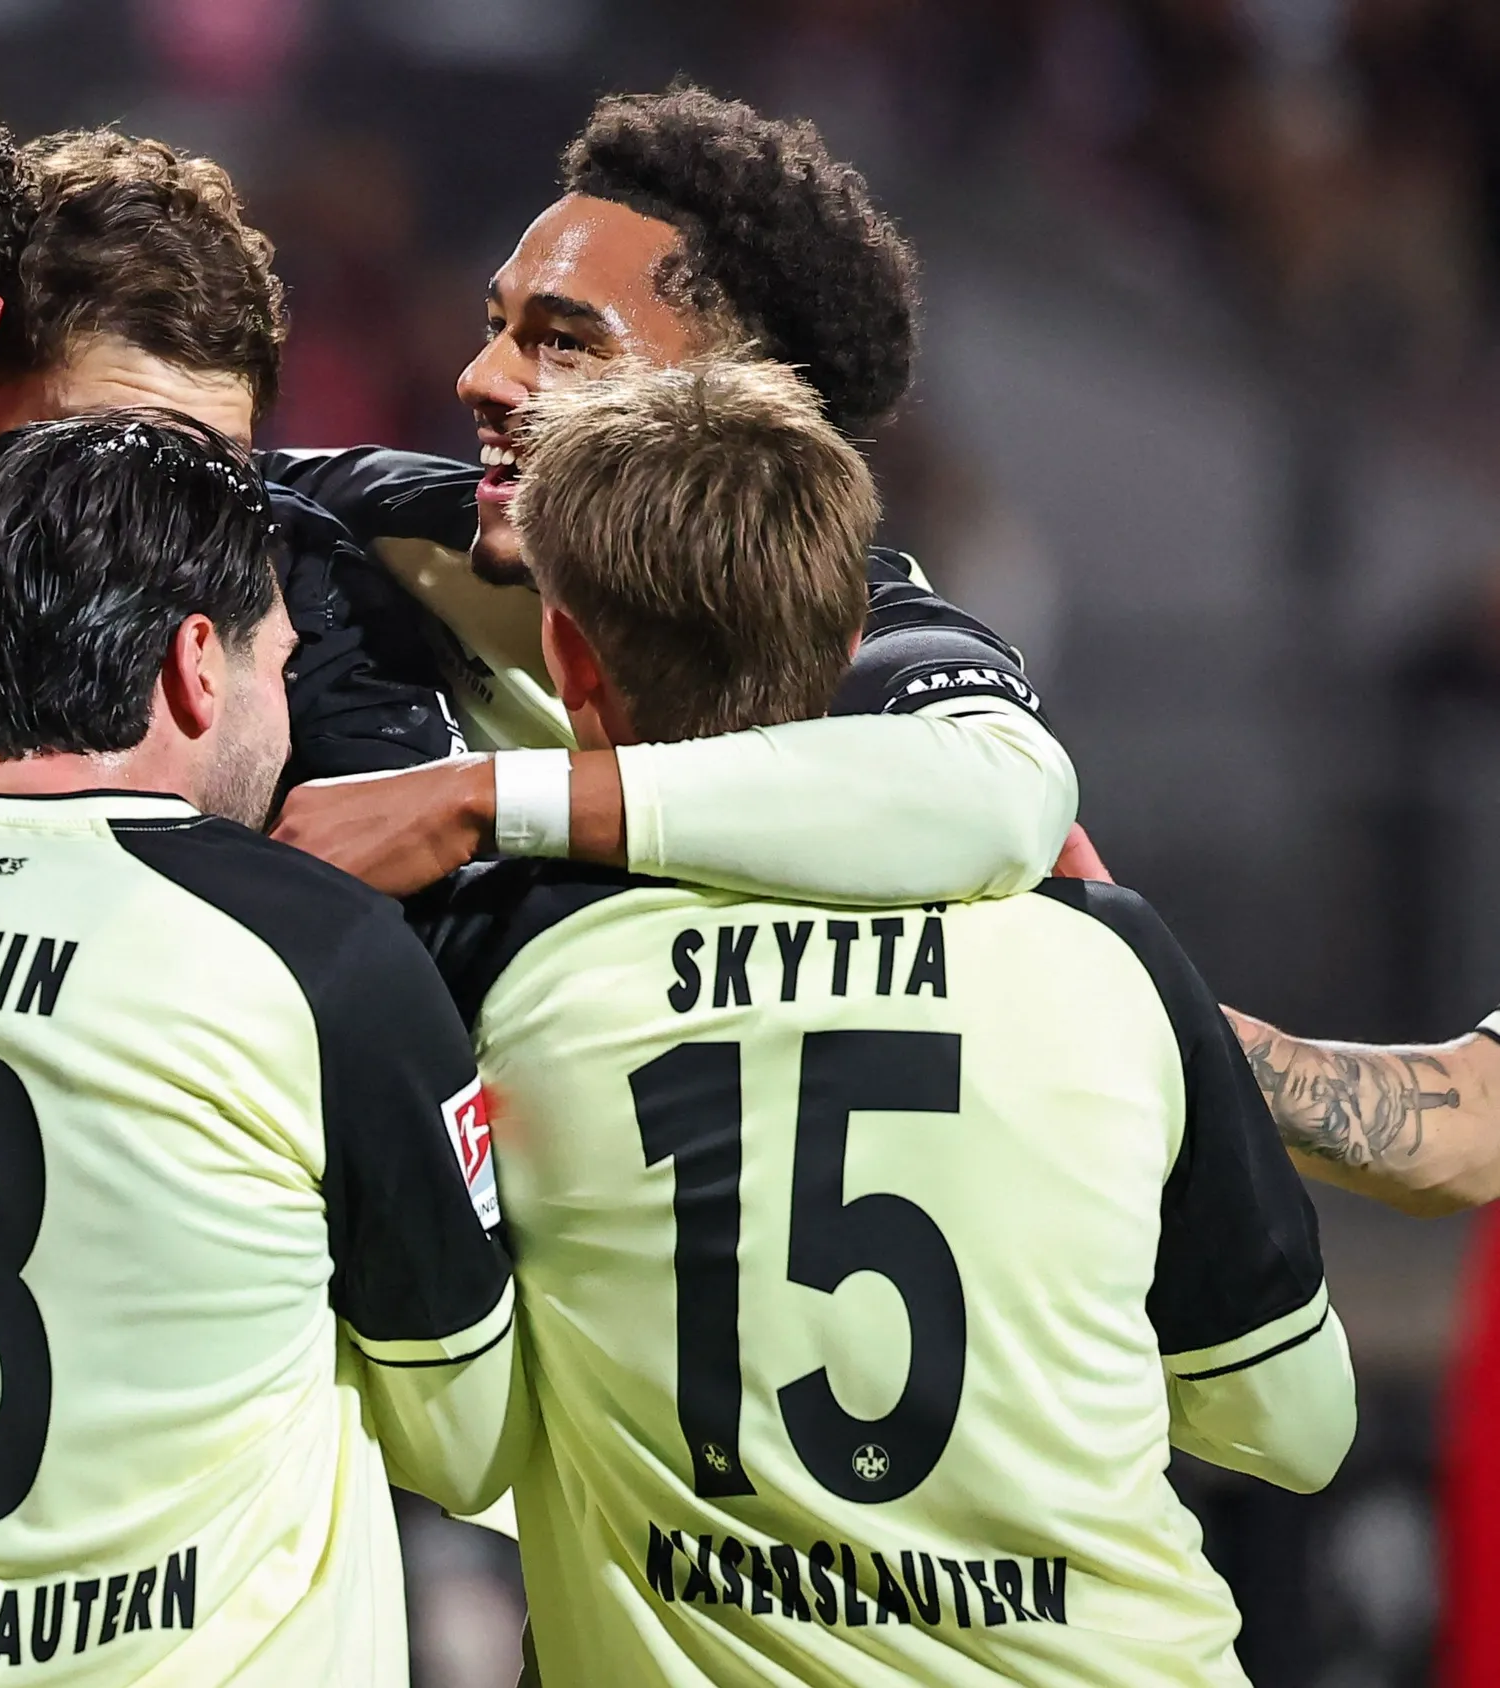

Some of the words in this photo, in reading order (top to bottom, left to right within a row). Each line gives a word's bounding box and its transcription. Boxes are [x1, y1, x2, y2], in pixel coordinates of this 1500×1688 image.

[667, 903, 948, 1012] SKYTTÄ
[628, 1029, 967, 1503] 15
[646, 1520, 1067, 1628] KASERSLAUTERN
